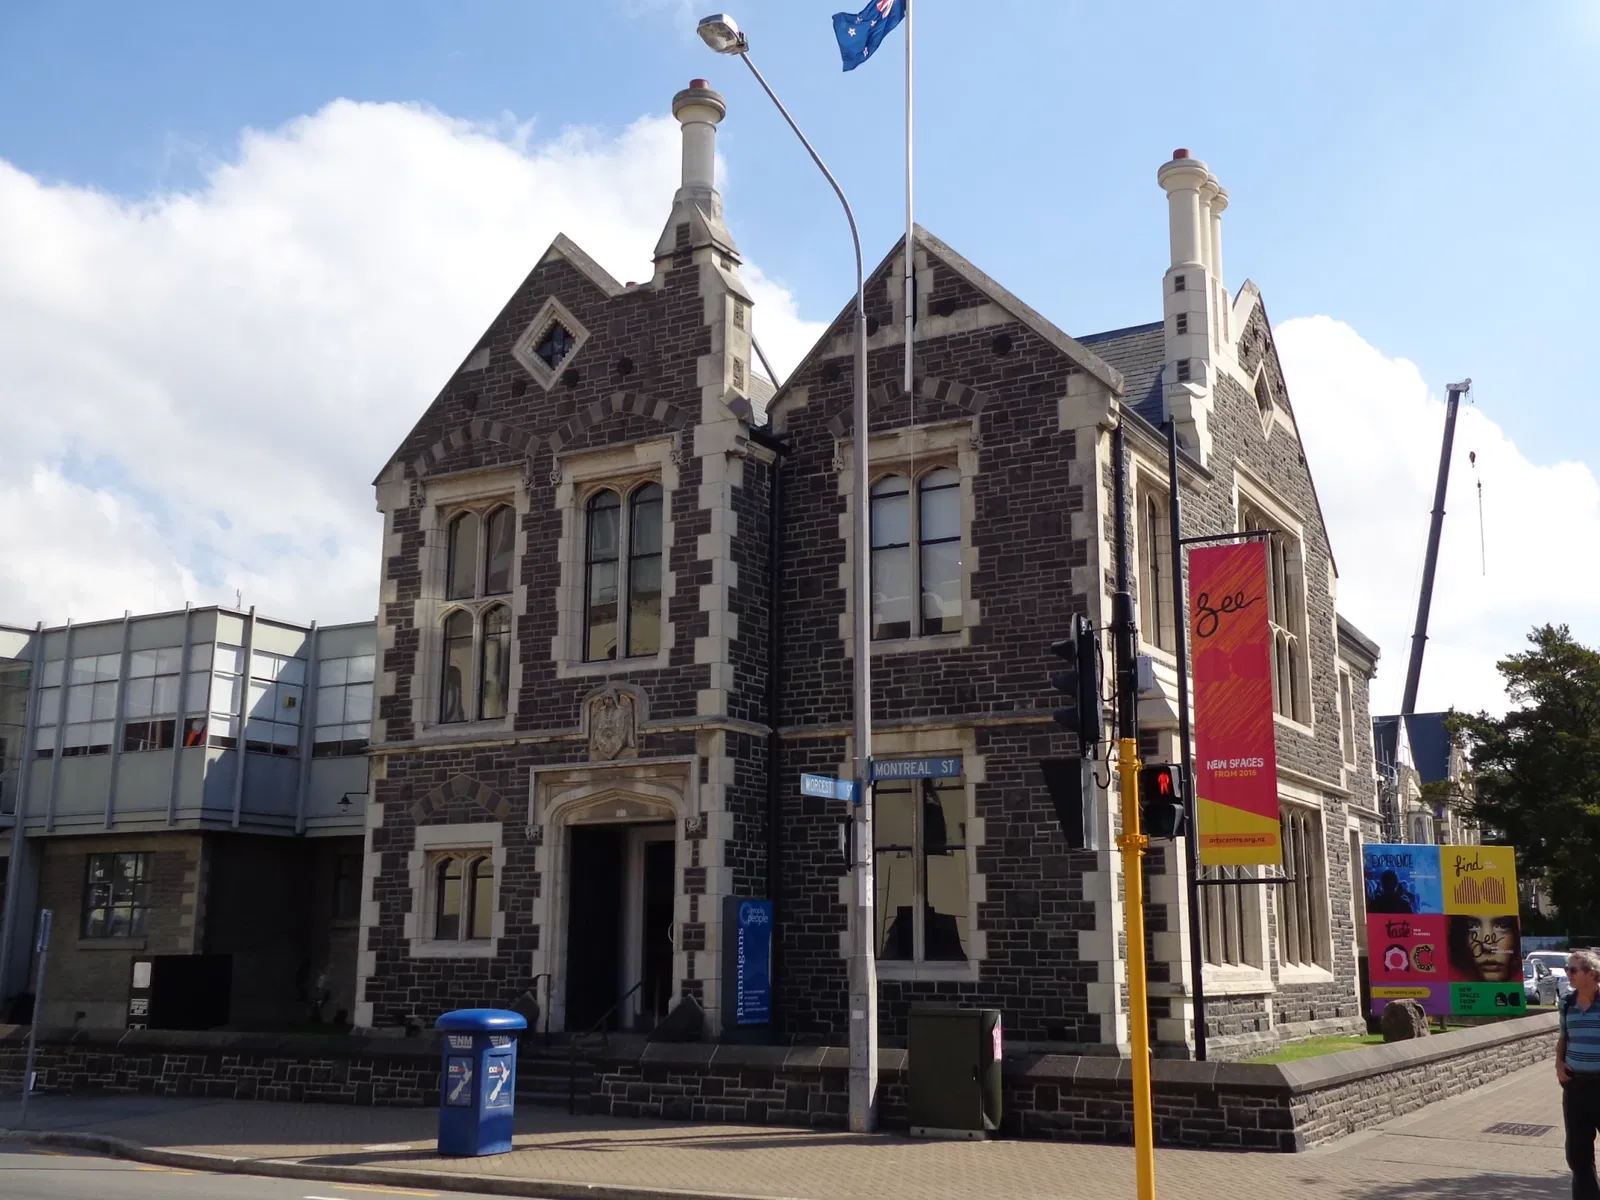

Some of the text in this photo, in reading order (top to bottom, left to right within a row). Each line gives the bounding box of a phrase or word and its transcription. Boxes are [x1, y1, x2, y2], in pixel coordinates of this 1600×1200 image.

[875, 760, 954, 777] MONTREAL ST
[1206, 757, 1264, 770] NEW SPACES
[1214, 769, 1257, 778] FROM 2016
[1371, 853, 1413, 869] EXPERIENCE
[1453, 852, 1484, 877] find
[737, 927, 745, 1017] Brannigans
